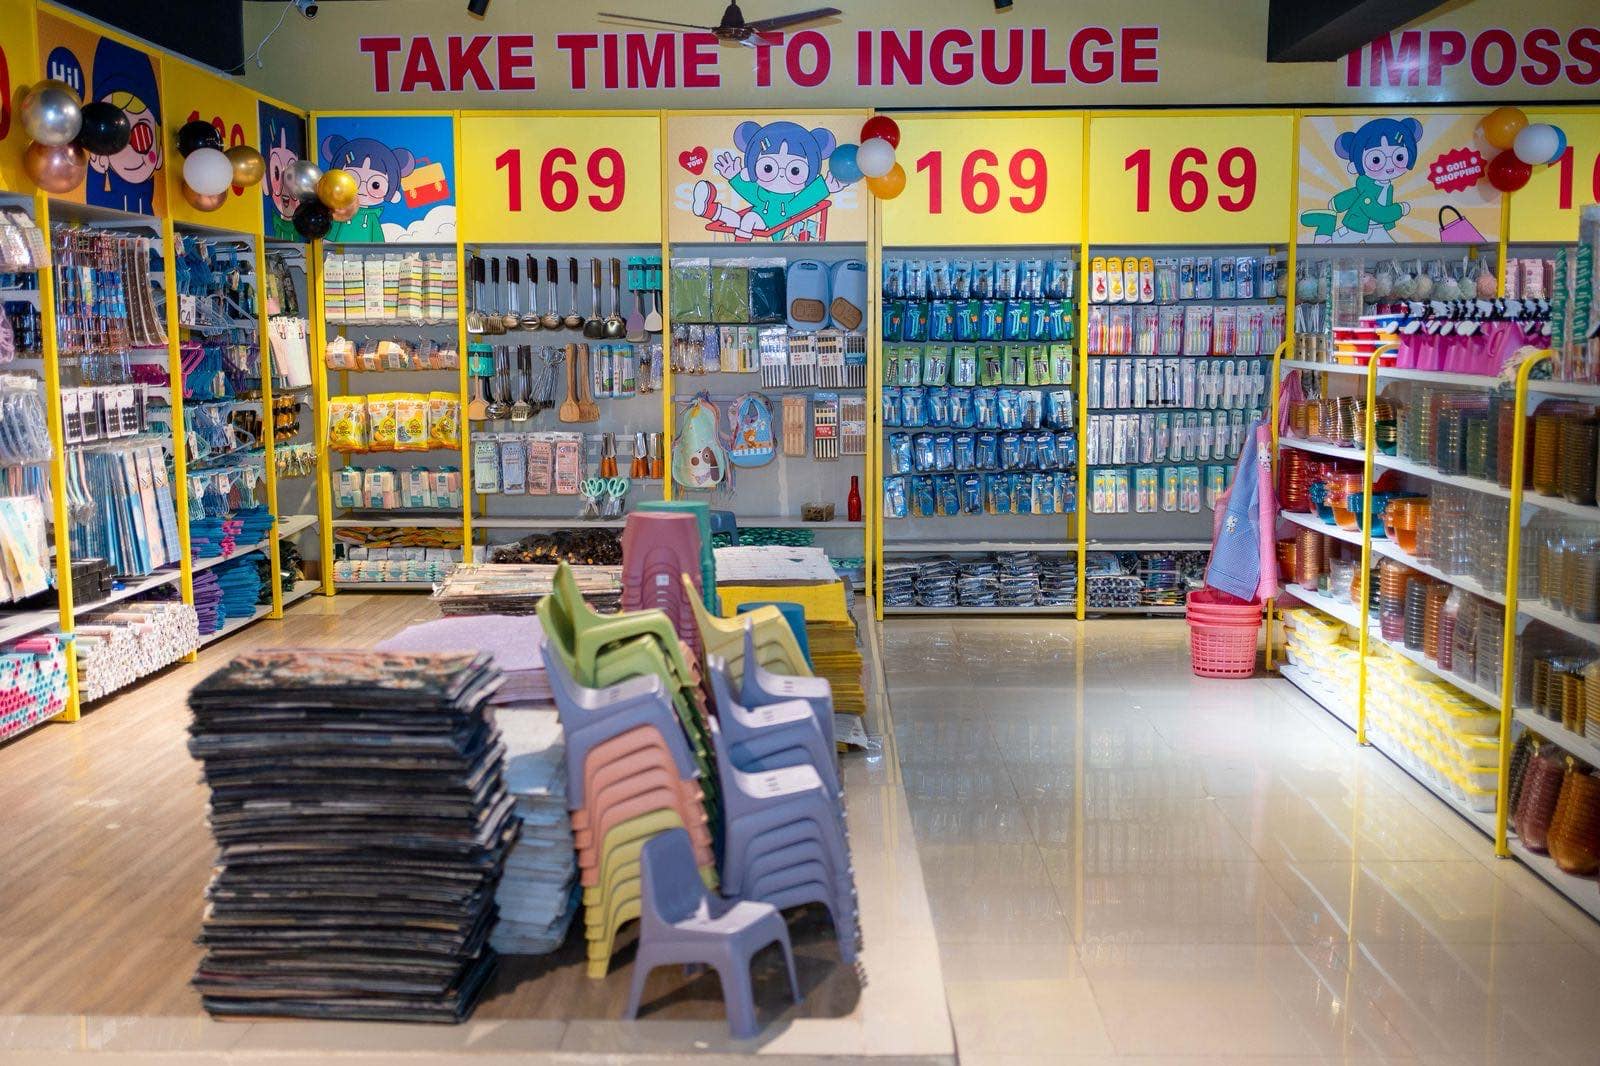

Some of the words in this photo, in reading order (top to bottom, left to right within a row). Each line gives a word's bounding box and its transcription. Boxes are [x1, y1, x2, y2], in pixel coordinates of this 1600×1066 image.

[360, 35, 536, 93] TAKE
[556, 32, 721, 89] TIME
[752, 29, 831, 88] TO
[857, 27, 1159, 86] INGULGE
[495, 147, 626, 213] 169
[915, 148, 1048, 214] 169
[1124, 147, 1258, 213] 169
[1435, 165, 1482, 185] SHOPPING
[1446, 160, 1467, 172] GO!!
